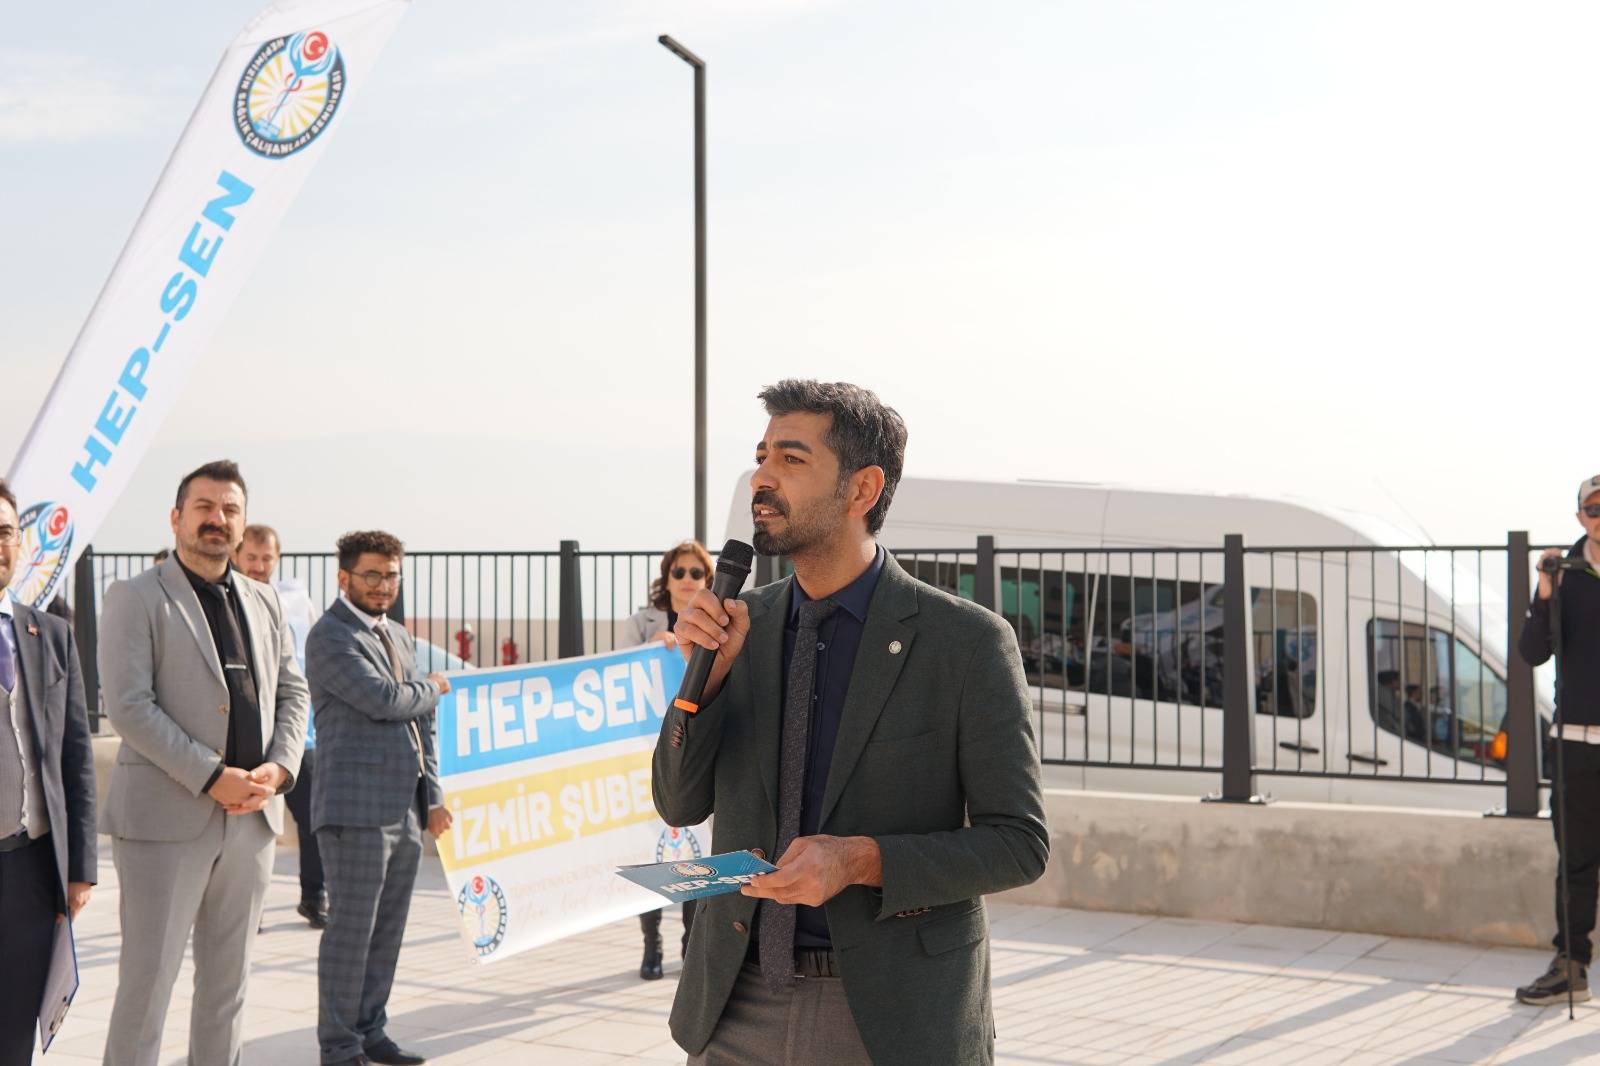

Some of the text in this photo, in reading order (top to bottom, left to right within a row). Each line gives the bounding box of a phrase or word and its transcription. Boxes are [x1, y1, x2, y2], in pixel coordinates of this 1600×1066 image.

[70, 169, 255, 493] HEP-SEN
[456, 658, 667, 757] HEP-SEN
[451, 767, 655, 860] İZMİR ŞUBE
